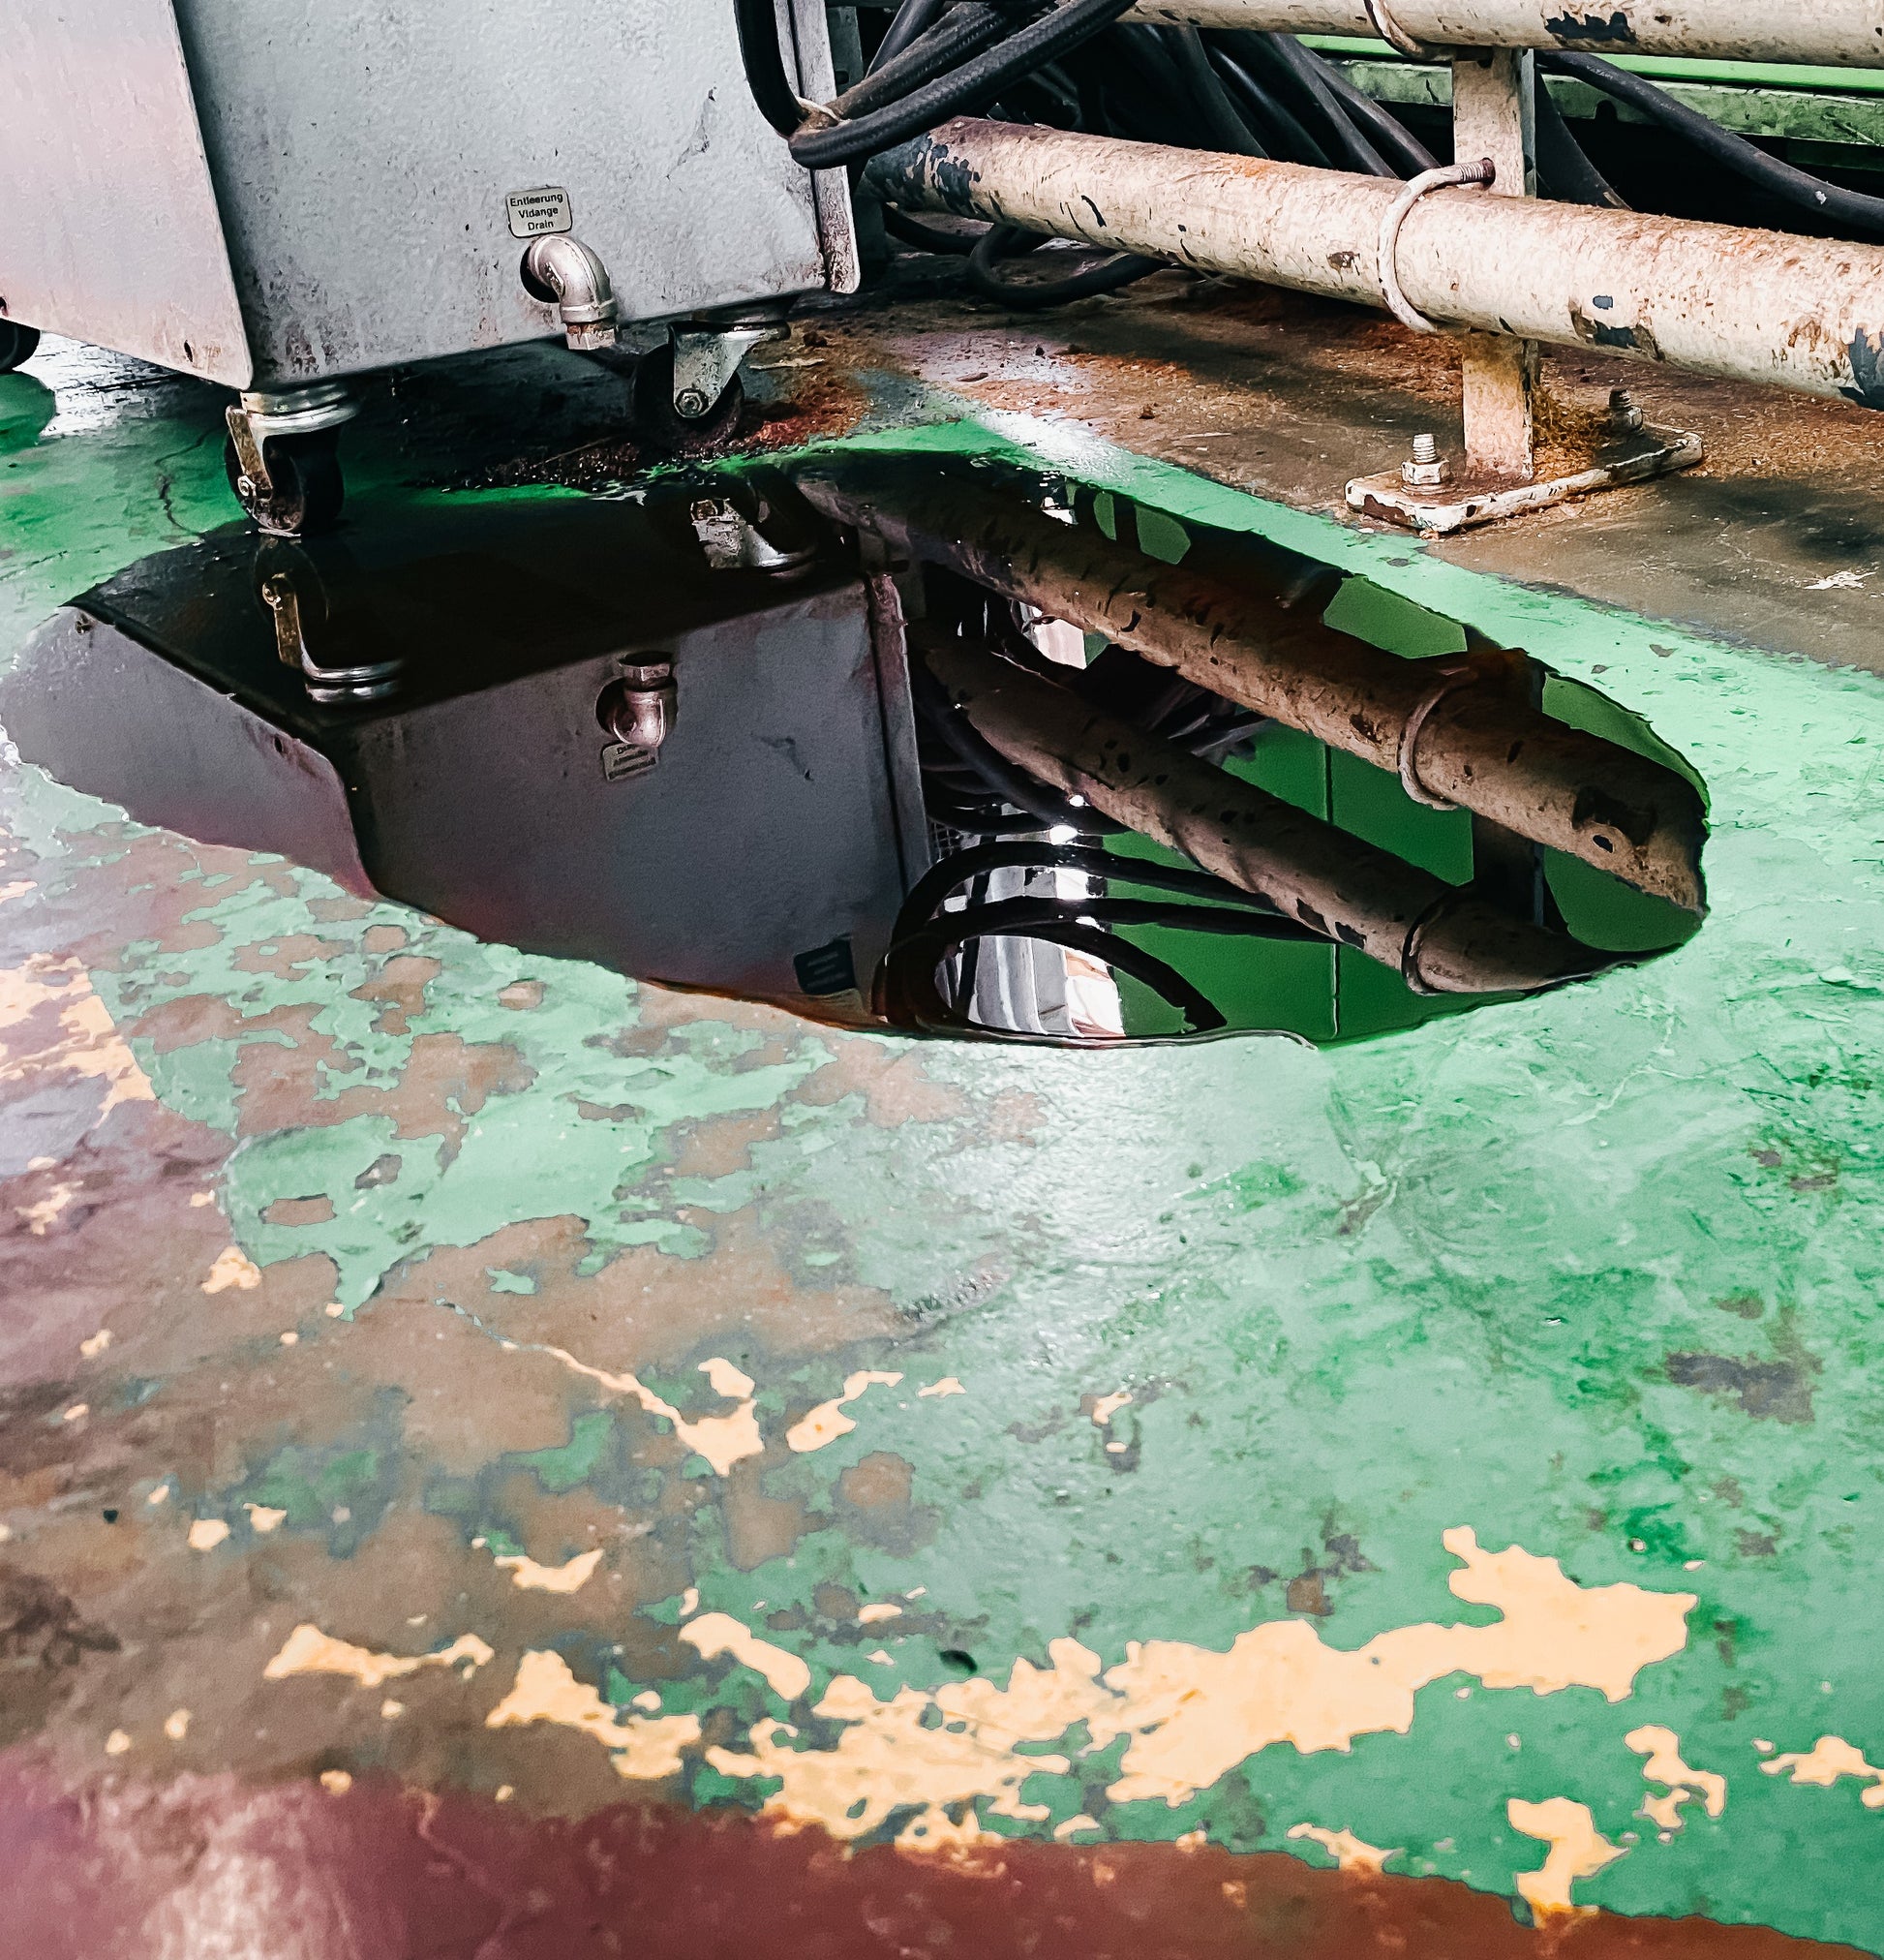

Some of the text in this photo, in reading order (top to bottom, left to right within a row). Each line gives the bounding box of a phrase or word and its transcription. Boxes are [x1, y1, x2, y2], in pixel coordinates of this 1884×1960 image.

[510, 194, 563, 206] Entleerung
[518, 207, 559, 219] Vidange
[528, 220, 554, 230] Drain
